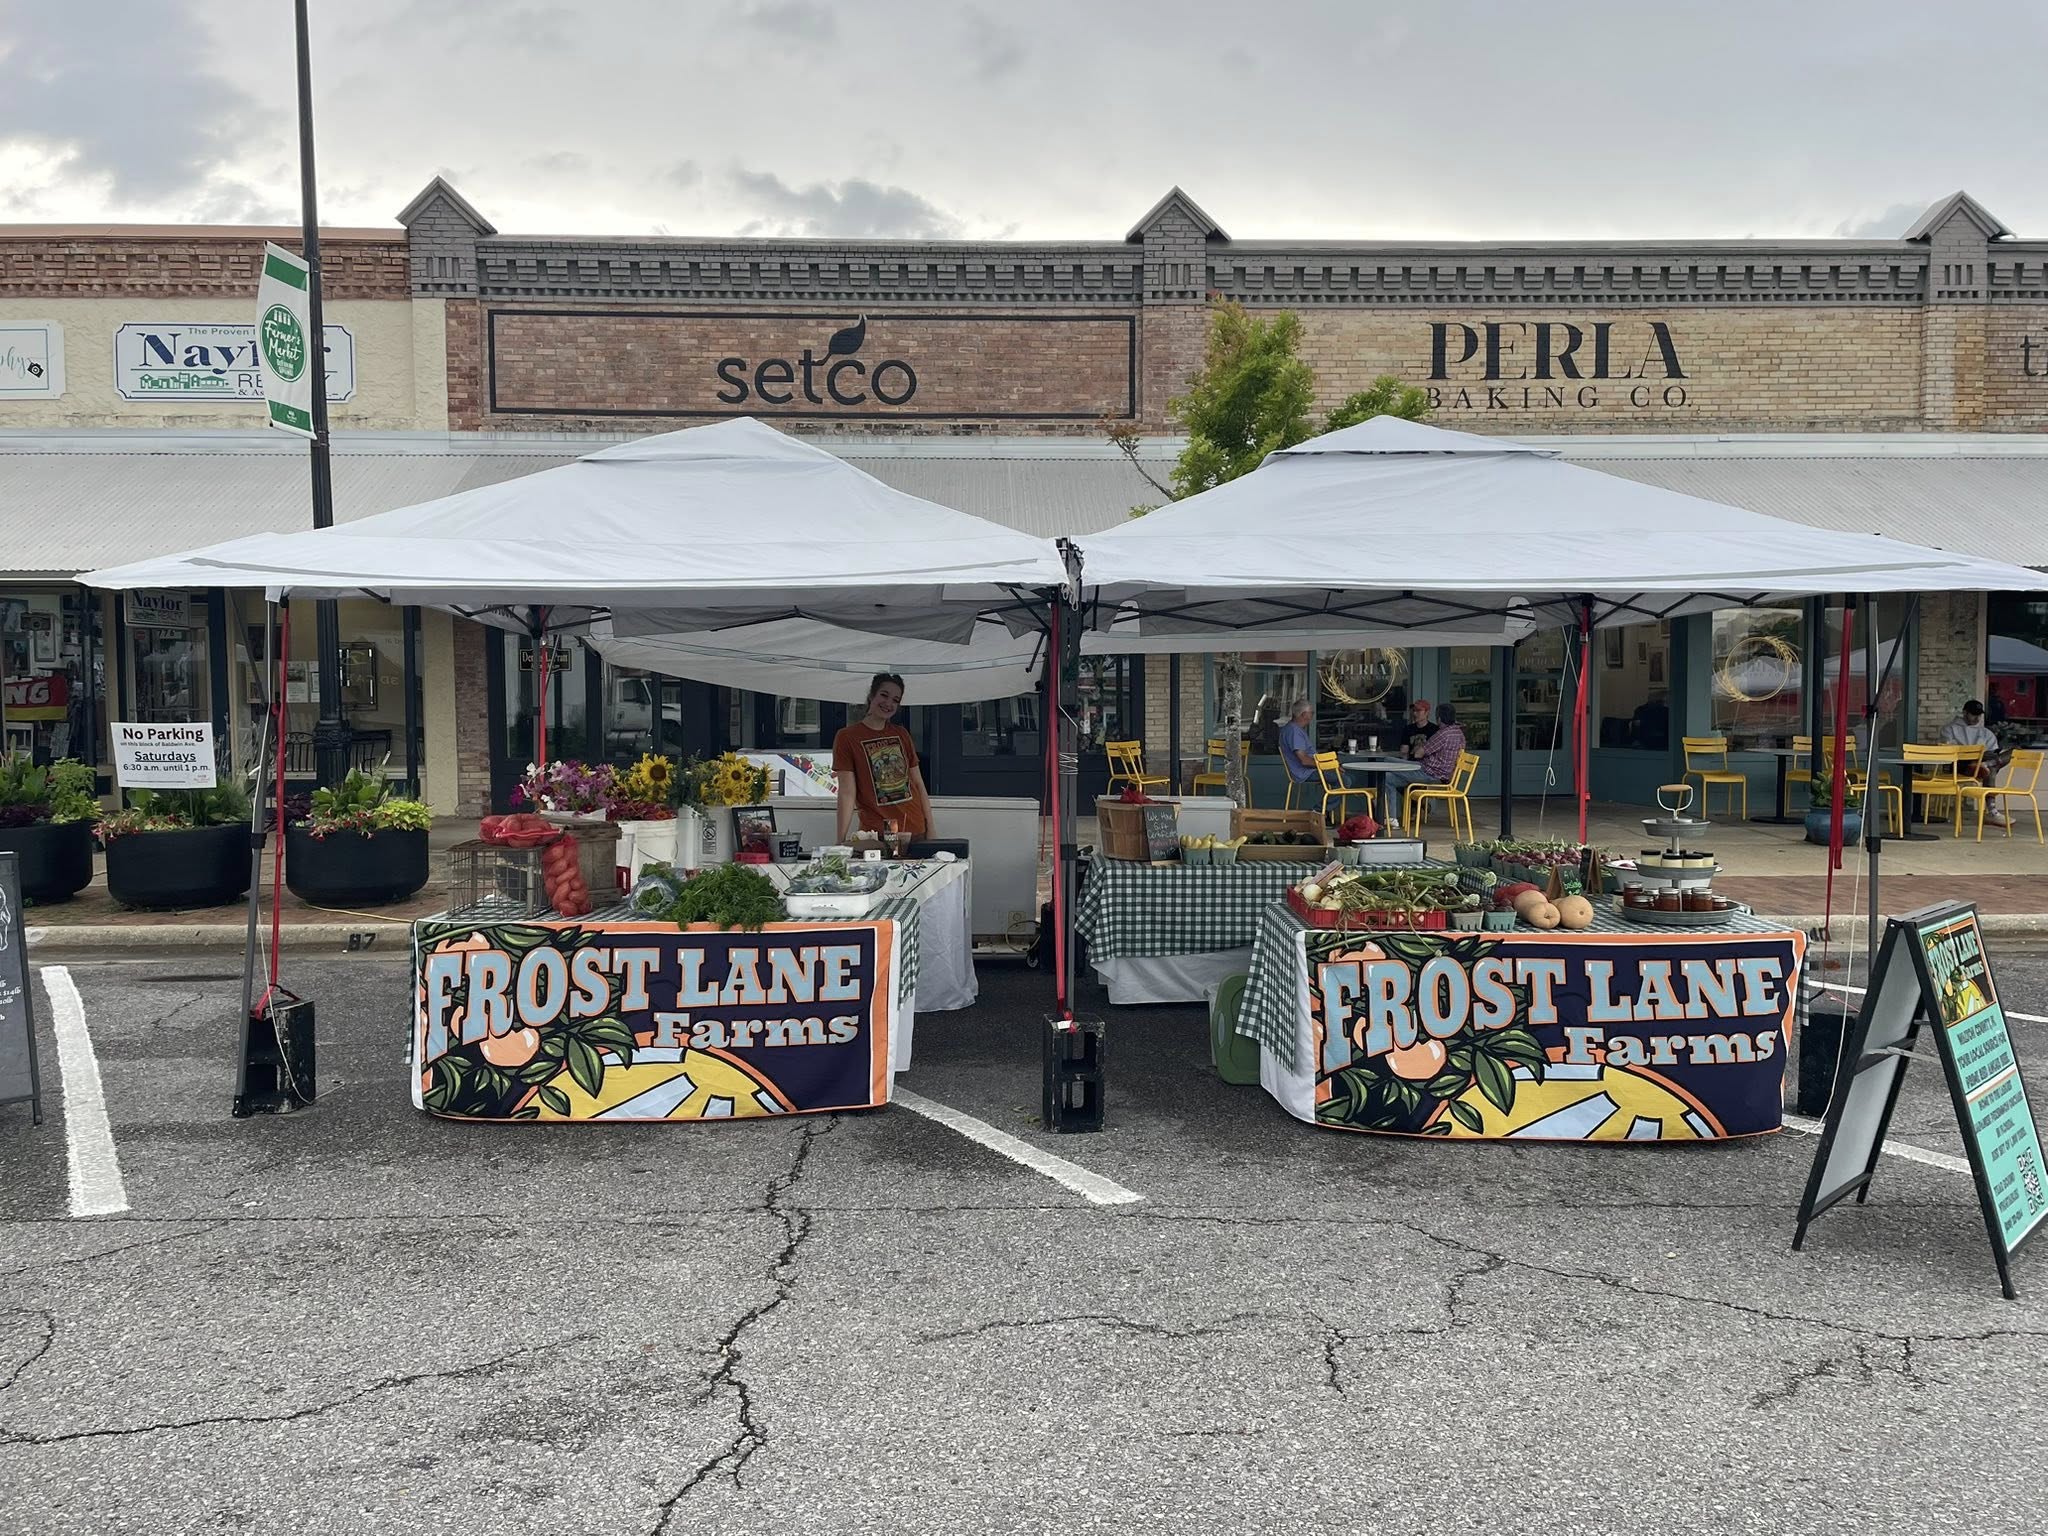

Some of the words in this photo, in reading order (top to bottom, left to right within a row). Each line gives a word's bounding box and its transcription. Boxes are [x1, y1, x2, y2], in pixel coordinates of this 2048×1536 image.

[188, 327, 207, 335] The
[211, 327, 249, 335] Proven
[136, 332, 260, 375] Nayl
[1426, 322, 1689, 380] PERLA
[716, 349, 918, 406] setco
[1425, 386, 1599, 409] BAKING
[1630, 386, 1693, 408] CO.
[132, 590, 183, 611] Naylor
[122, 728, 143, 740] No
[147, 727, 204, 742] Parking
[134, 751, 196, 763] Saturdays
[163, 764, 184, 772] until
[192, 765, 211, 773] p.m.
[423, 946, 660, 1063] FROST
[677, 944, 863, 1010] LANE
[1316, 955, 1567, 1076] FROST
[1584, 955, 1784, 1023] LANE
[652, 1011, 860, 1050] Farms
[1563, 1026, 1779, 1067] Farms
